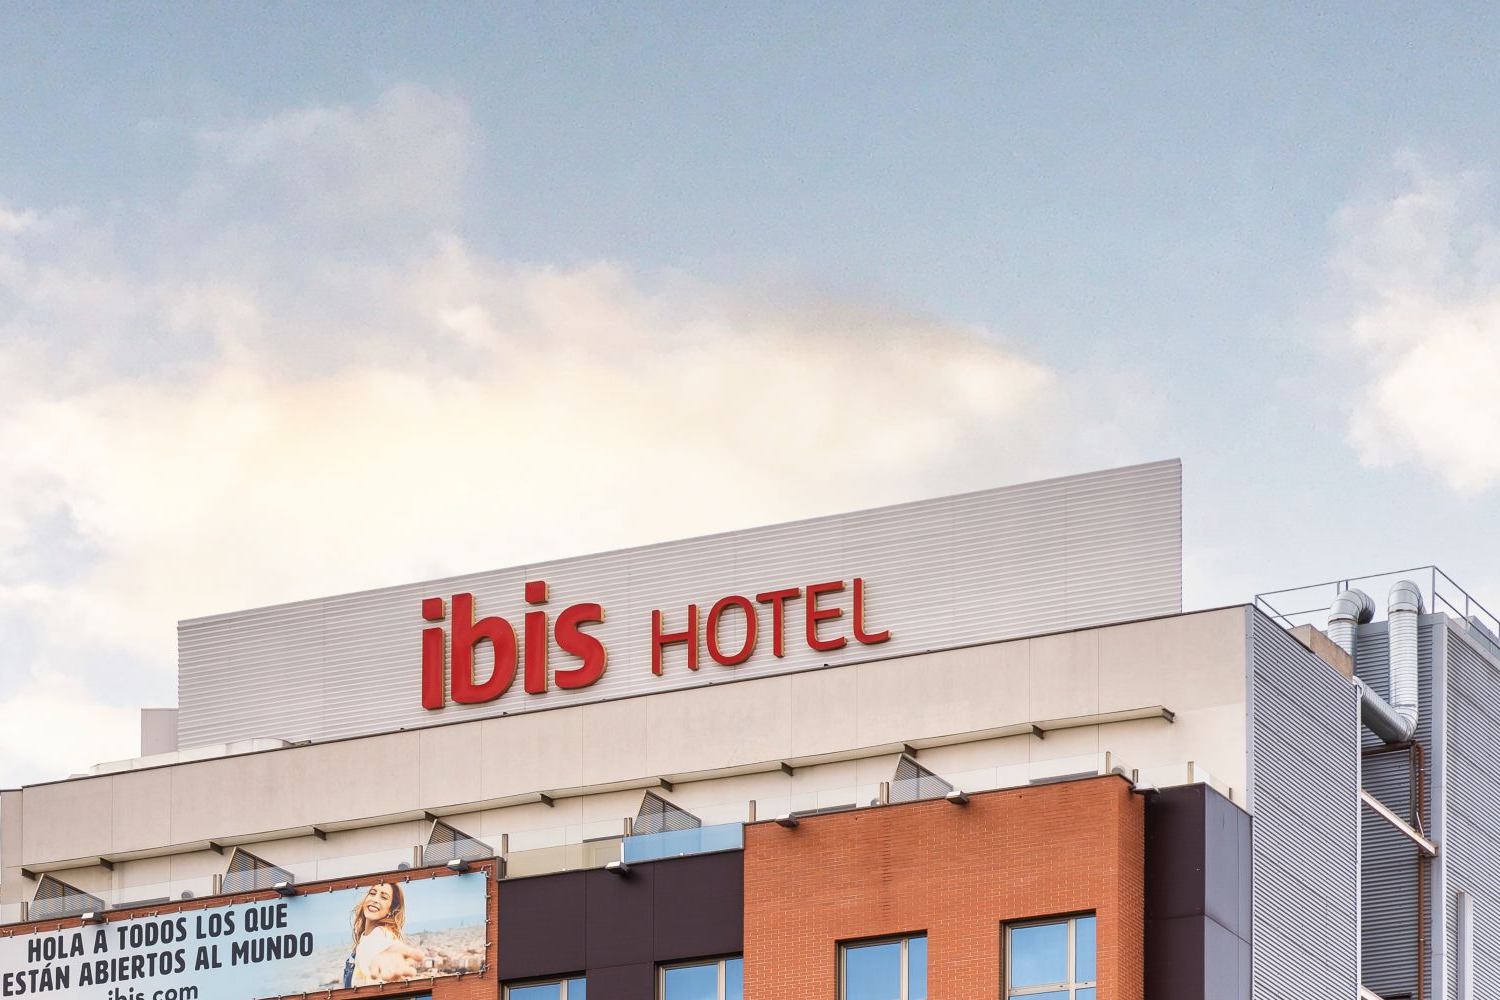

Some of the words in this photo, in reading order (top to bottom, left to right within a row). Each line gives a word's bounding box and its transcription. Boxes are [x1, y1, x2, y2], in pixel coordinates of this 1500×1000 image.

[422, 580, 608, 710] ibis
[651, 577, 892, 677] HOTEL
[2, 962, 70, 997] ESTÁN
[78, 948, 186, 987] ABIERTOS
[194, 944, 223, 971] AL
[231, 932, 314, 967] MUNDO
[28, 932, 85, 963] HOLA
[93, 929, 108, 954] A
[117, 917, 187, 951] TODOS
[196, 910, 235, 940] LOS
[244, 903, 288, 933] QUE
